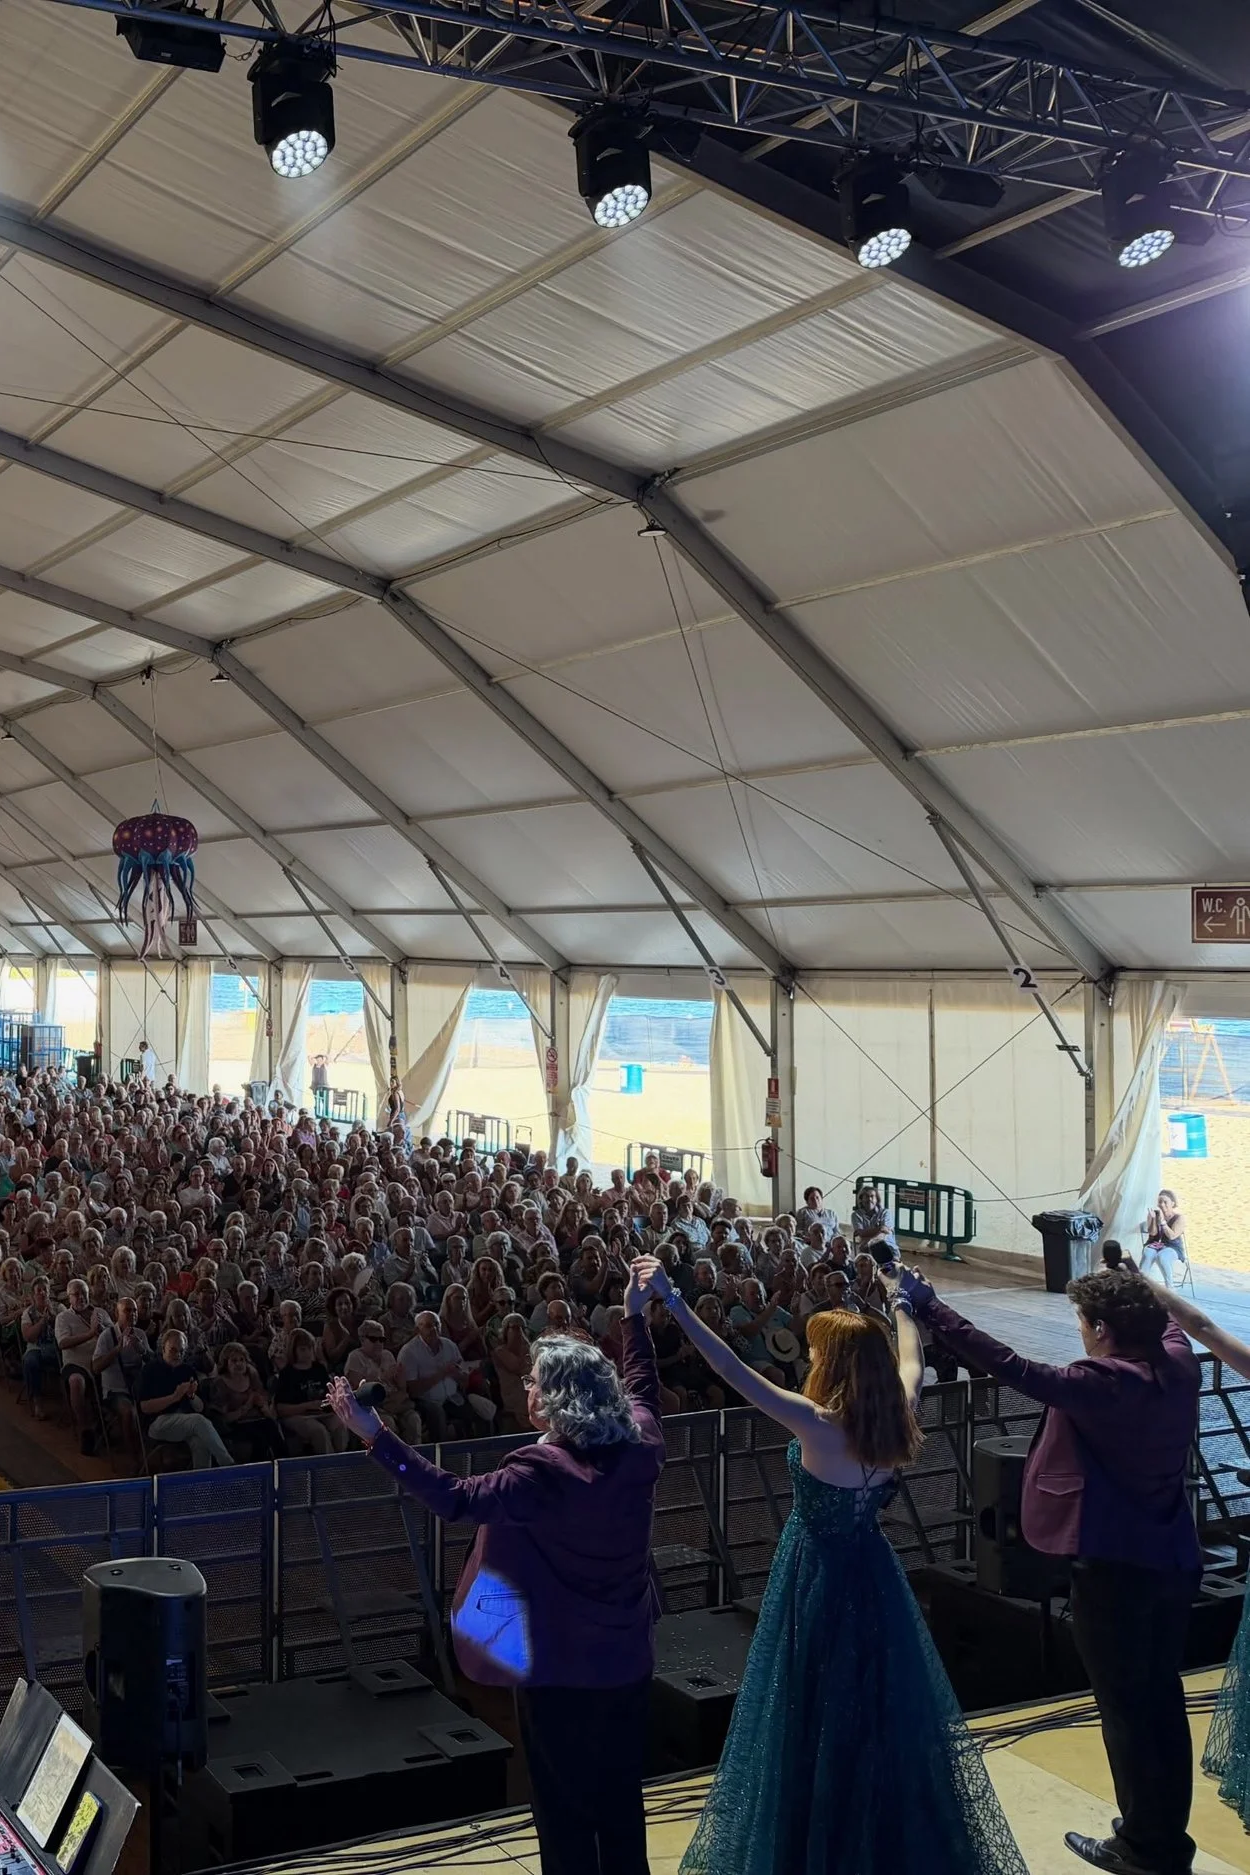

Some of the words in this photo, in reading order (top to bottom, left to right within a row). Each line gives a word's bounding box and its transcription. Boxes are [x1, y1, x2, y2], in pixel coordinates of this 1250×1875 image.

[1201, 897, 1227, 913] W.C.
[343, 958, 355, 970] 5
[499, 967, 510, 980] 4
[709, 968, 726, 986] 3
[1013, 967, 1038, 988] 2
